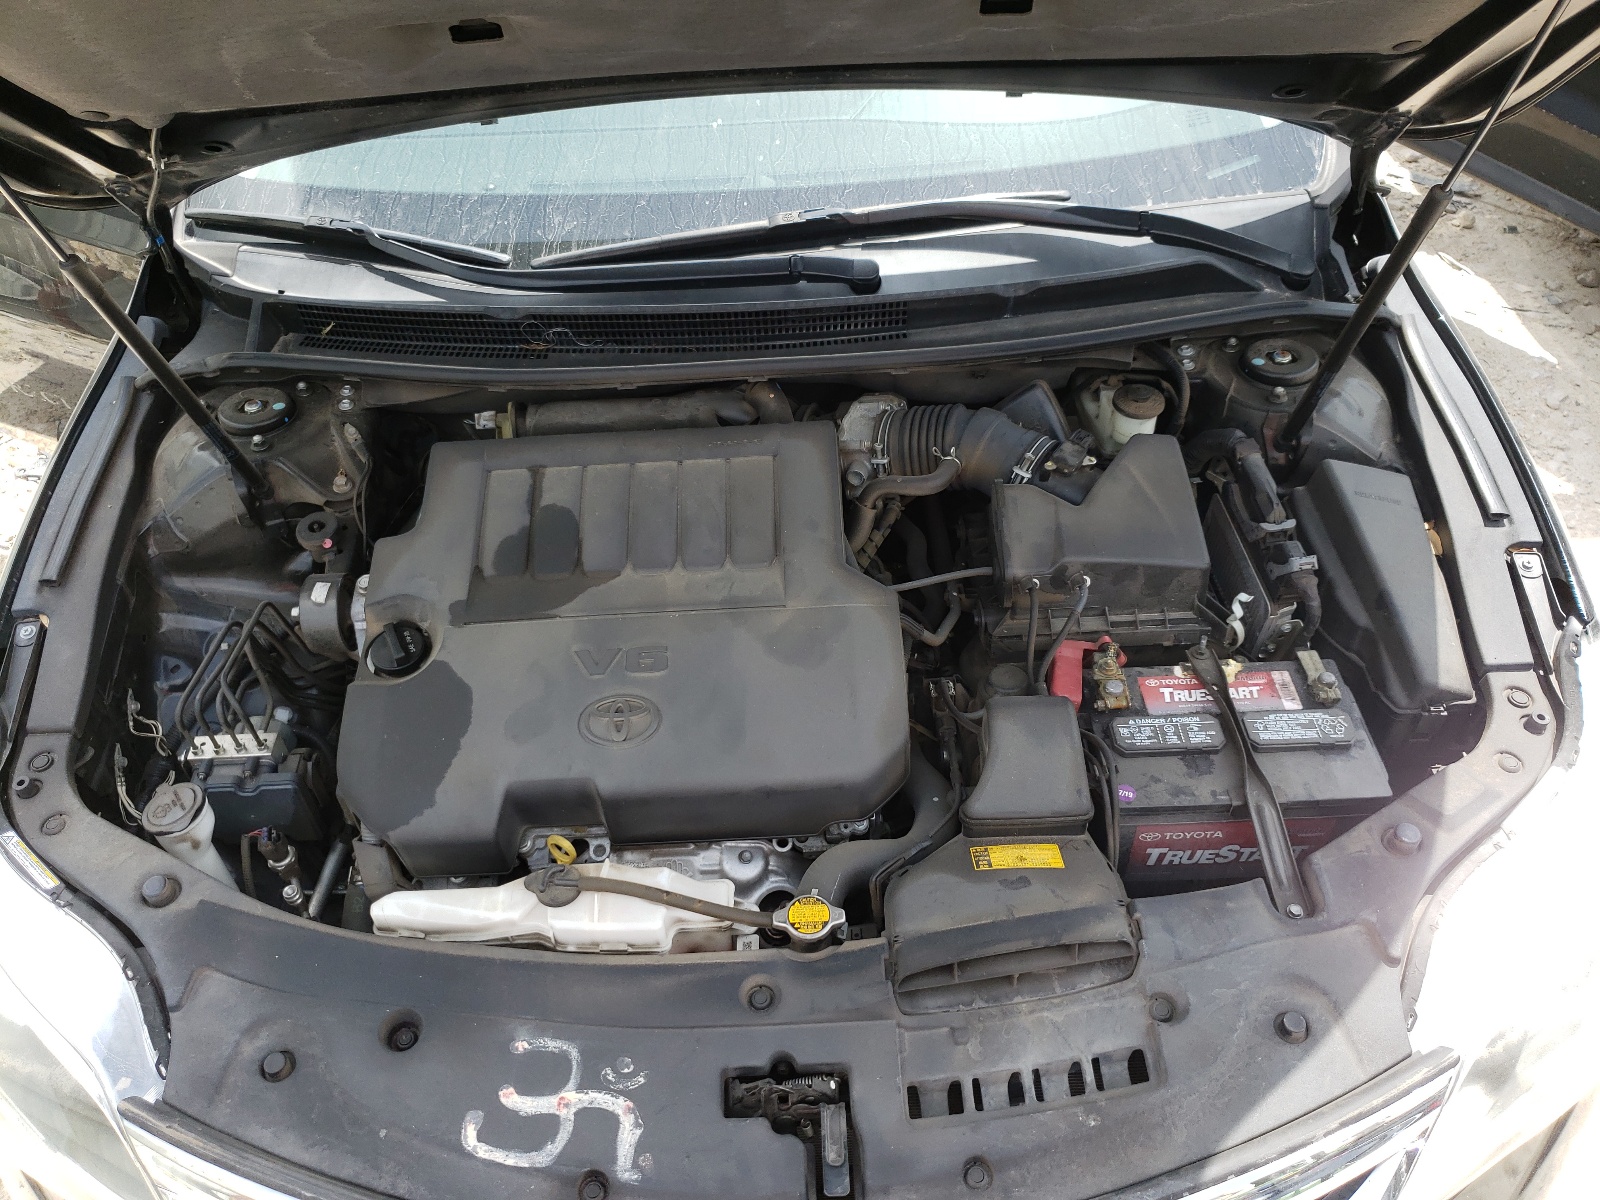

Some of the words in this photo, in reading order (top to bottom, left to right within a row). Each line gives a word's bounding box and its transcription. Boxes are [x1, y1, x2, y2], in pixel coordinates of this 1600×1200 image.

[572, 645, 669, 677] V6
[1159, 685, 1260, 703] TRUEART
[1164, 830, 1223, 840] TOYOTA
